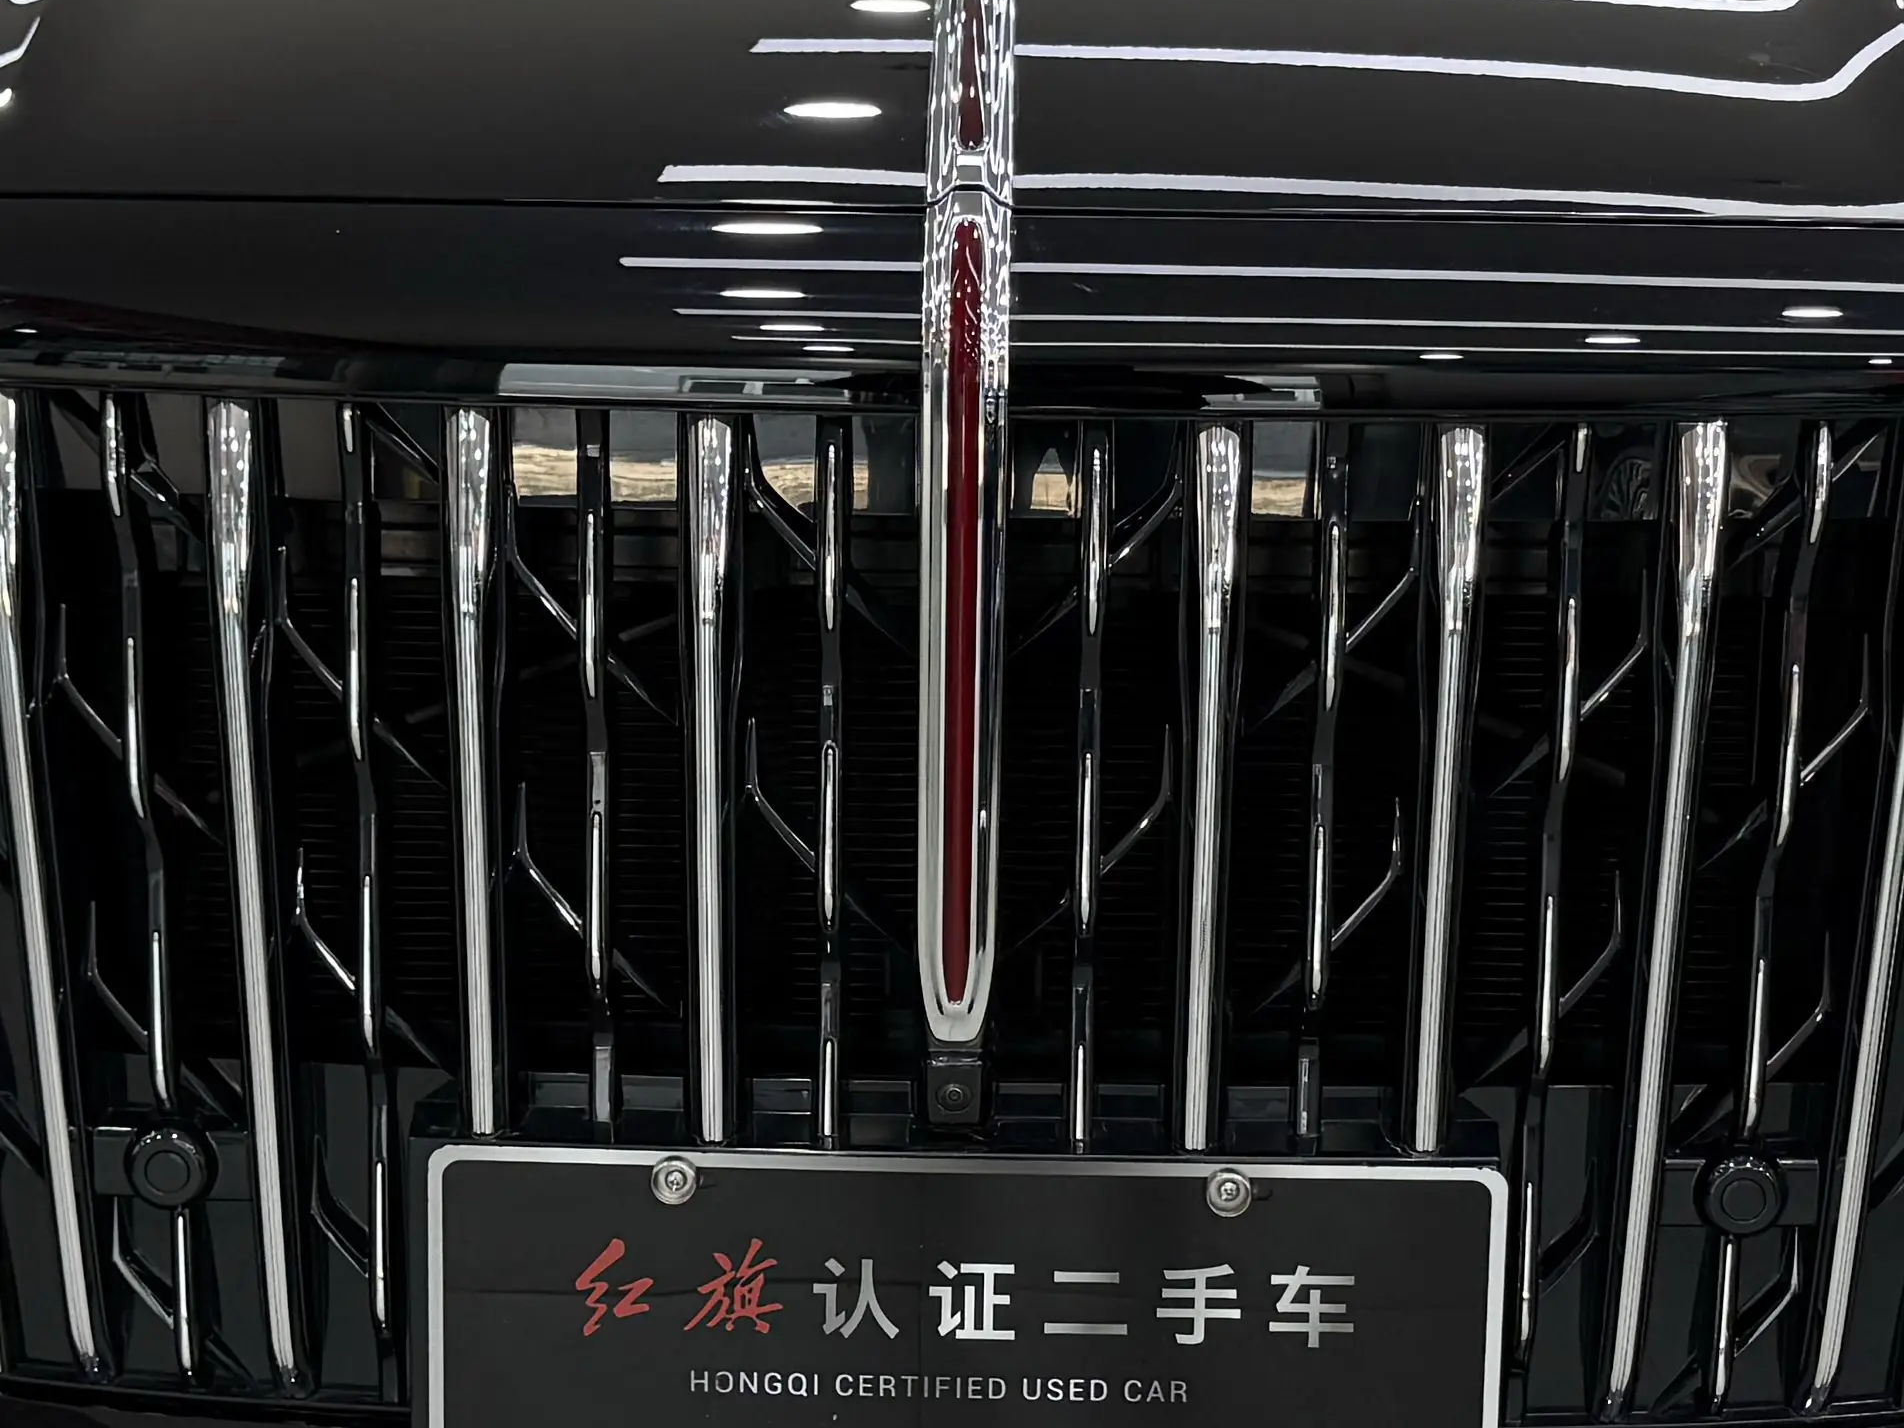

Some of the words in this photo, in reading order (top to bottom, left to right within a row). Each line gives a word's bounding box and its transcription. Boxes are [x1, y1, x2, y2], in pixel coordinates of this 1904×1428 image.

[573, 1237, 1357, 1350] 红旗认证二手车
[689, 1369, 820, 1396] HONGQI
[832, 1373, 1007, 1400] CERTIFIED
[1022, 1377, 1108, 1402] USED
[1124, 1379, 1187, 1403] CAR
